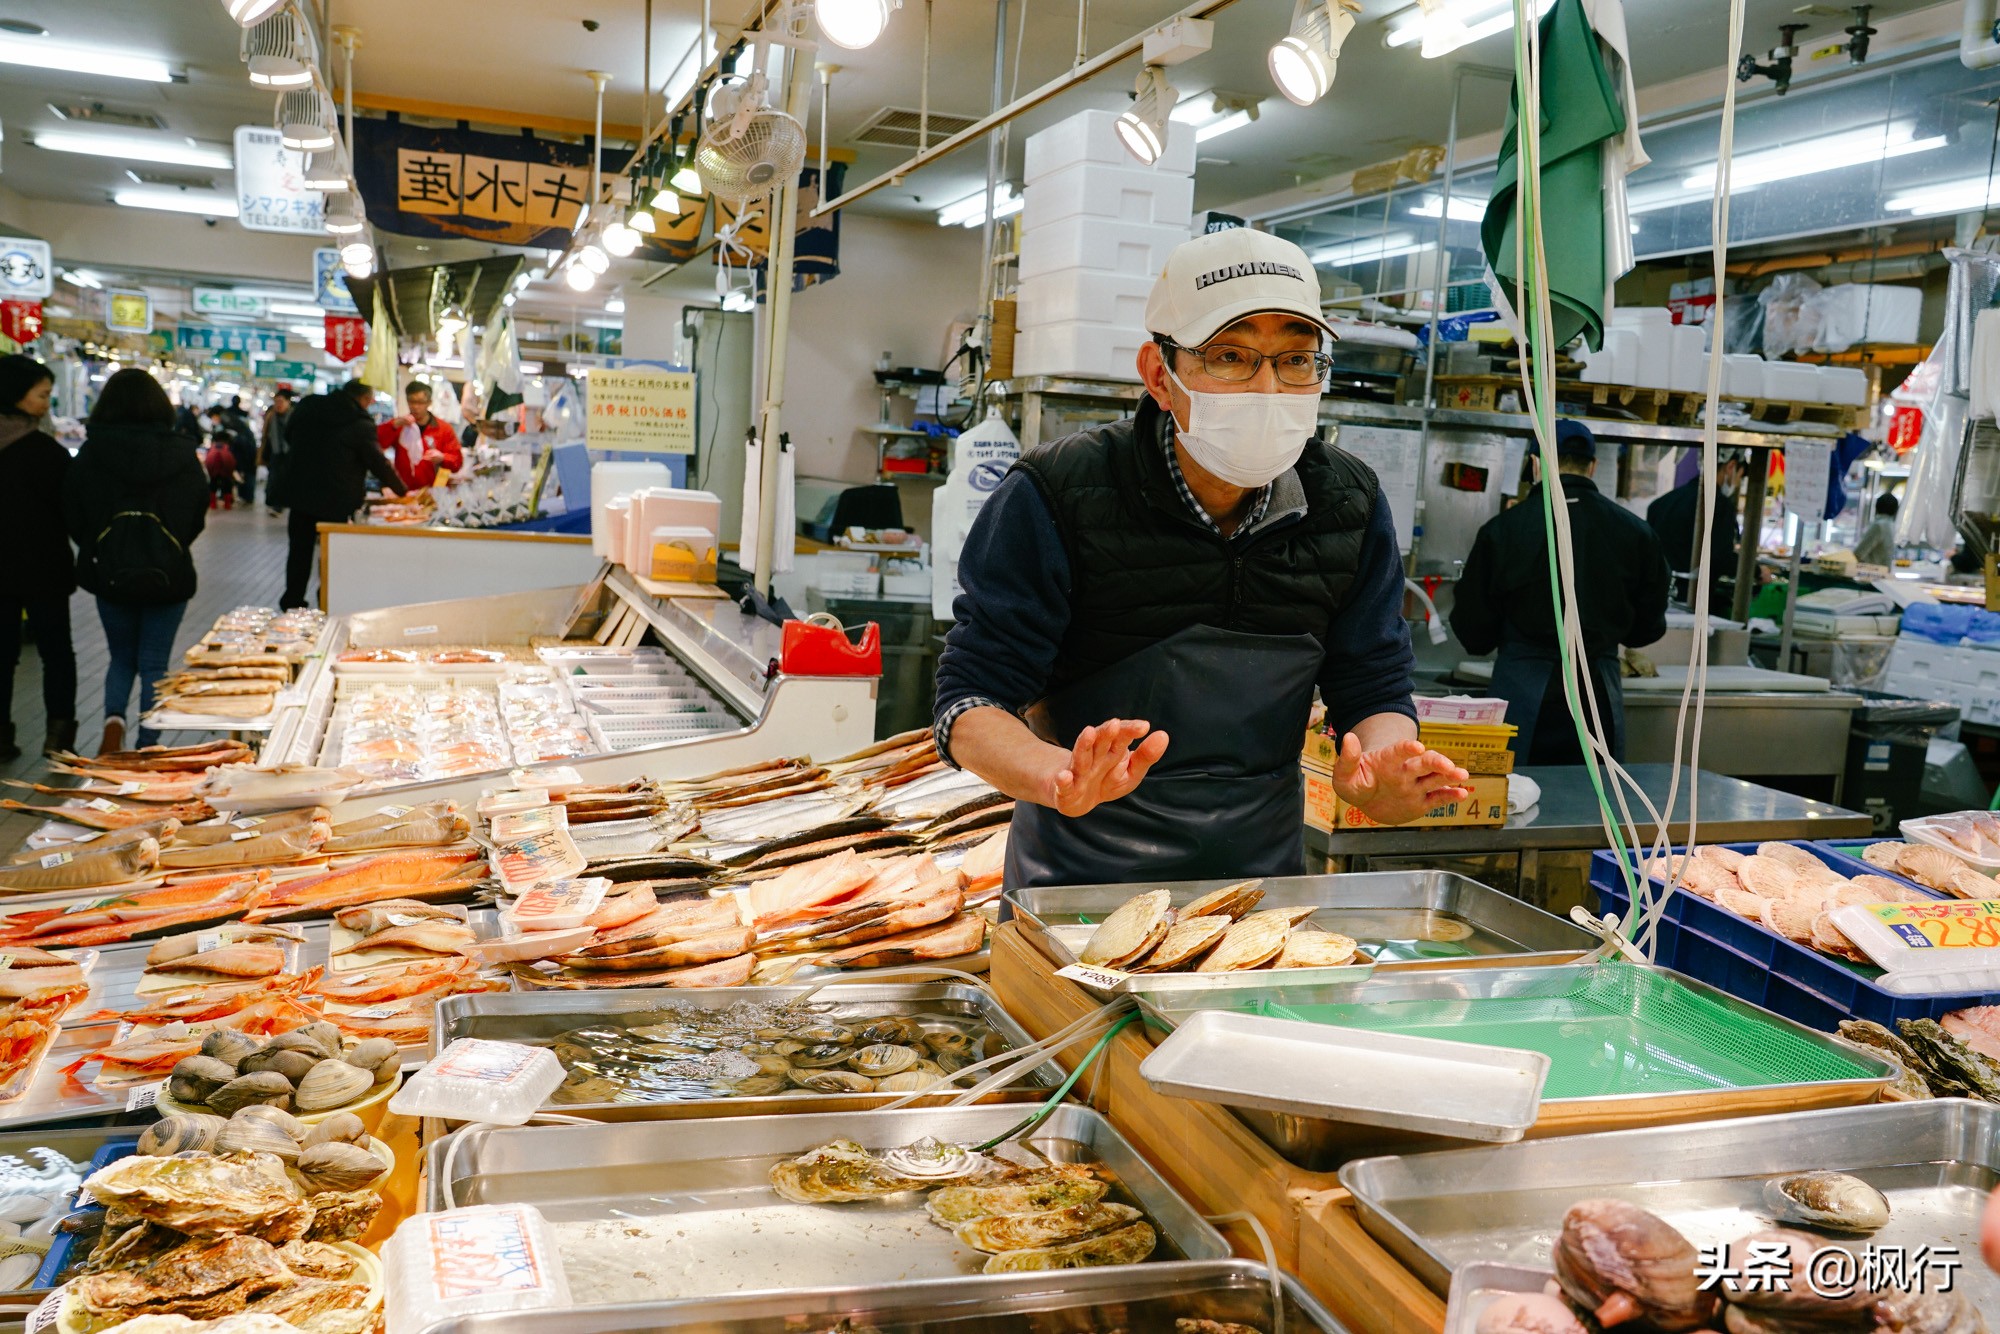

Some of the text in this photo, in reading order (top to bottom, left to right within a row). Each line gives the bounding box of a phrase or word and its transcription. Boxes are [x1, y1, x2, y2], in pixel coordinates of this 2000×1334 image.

[1196, 261, 1305, 290] HUMMER
[593, 403, 687, 419] 消費税10%価格
[1466, 799, 1480, 820] 4
[1488, 804, 1501, 818] 尾
[1901, 904, 1982, 918] ホタテ
[1081, 970, 1120, 985] ¥2000
